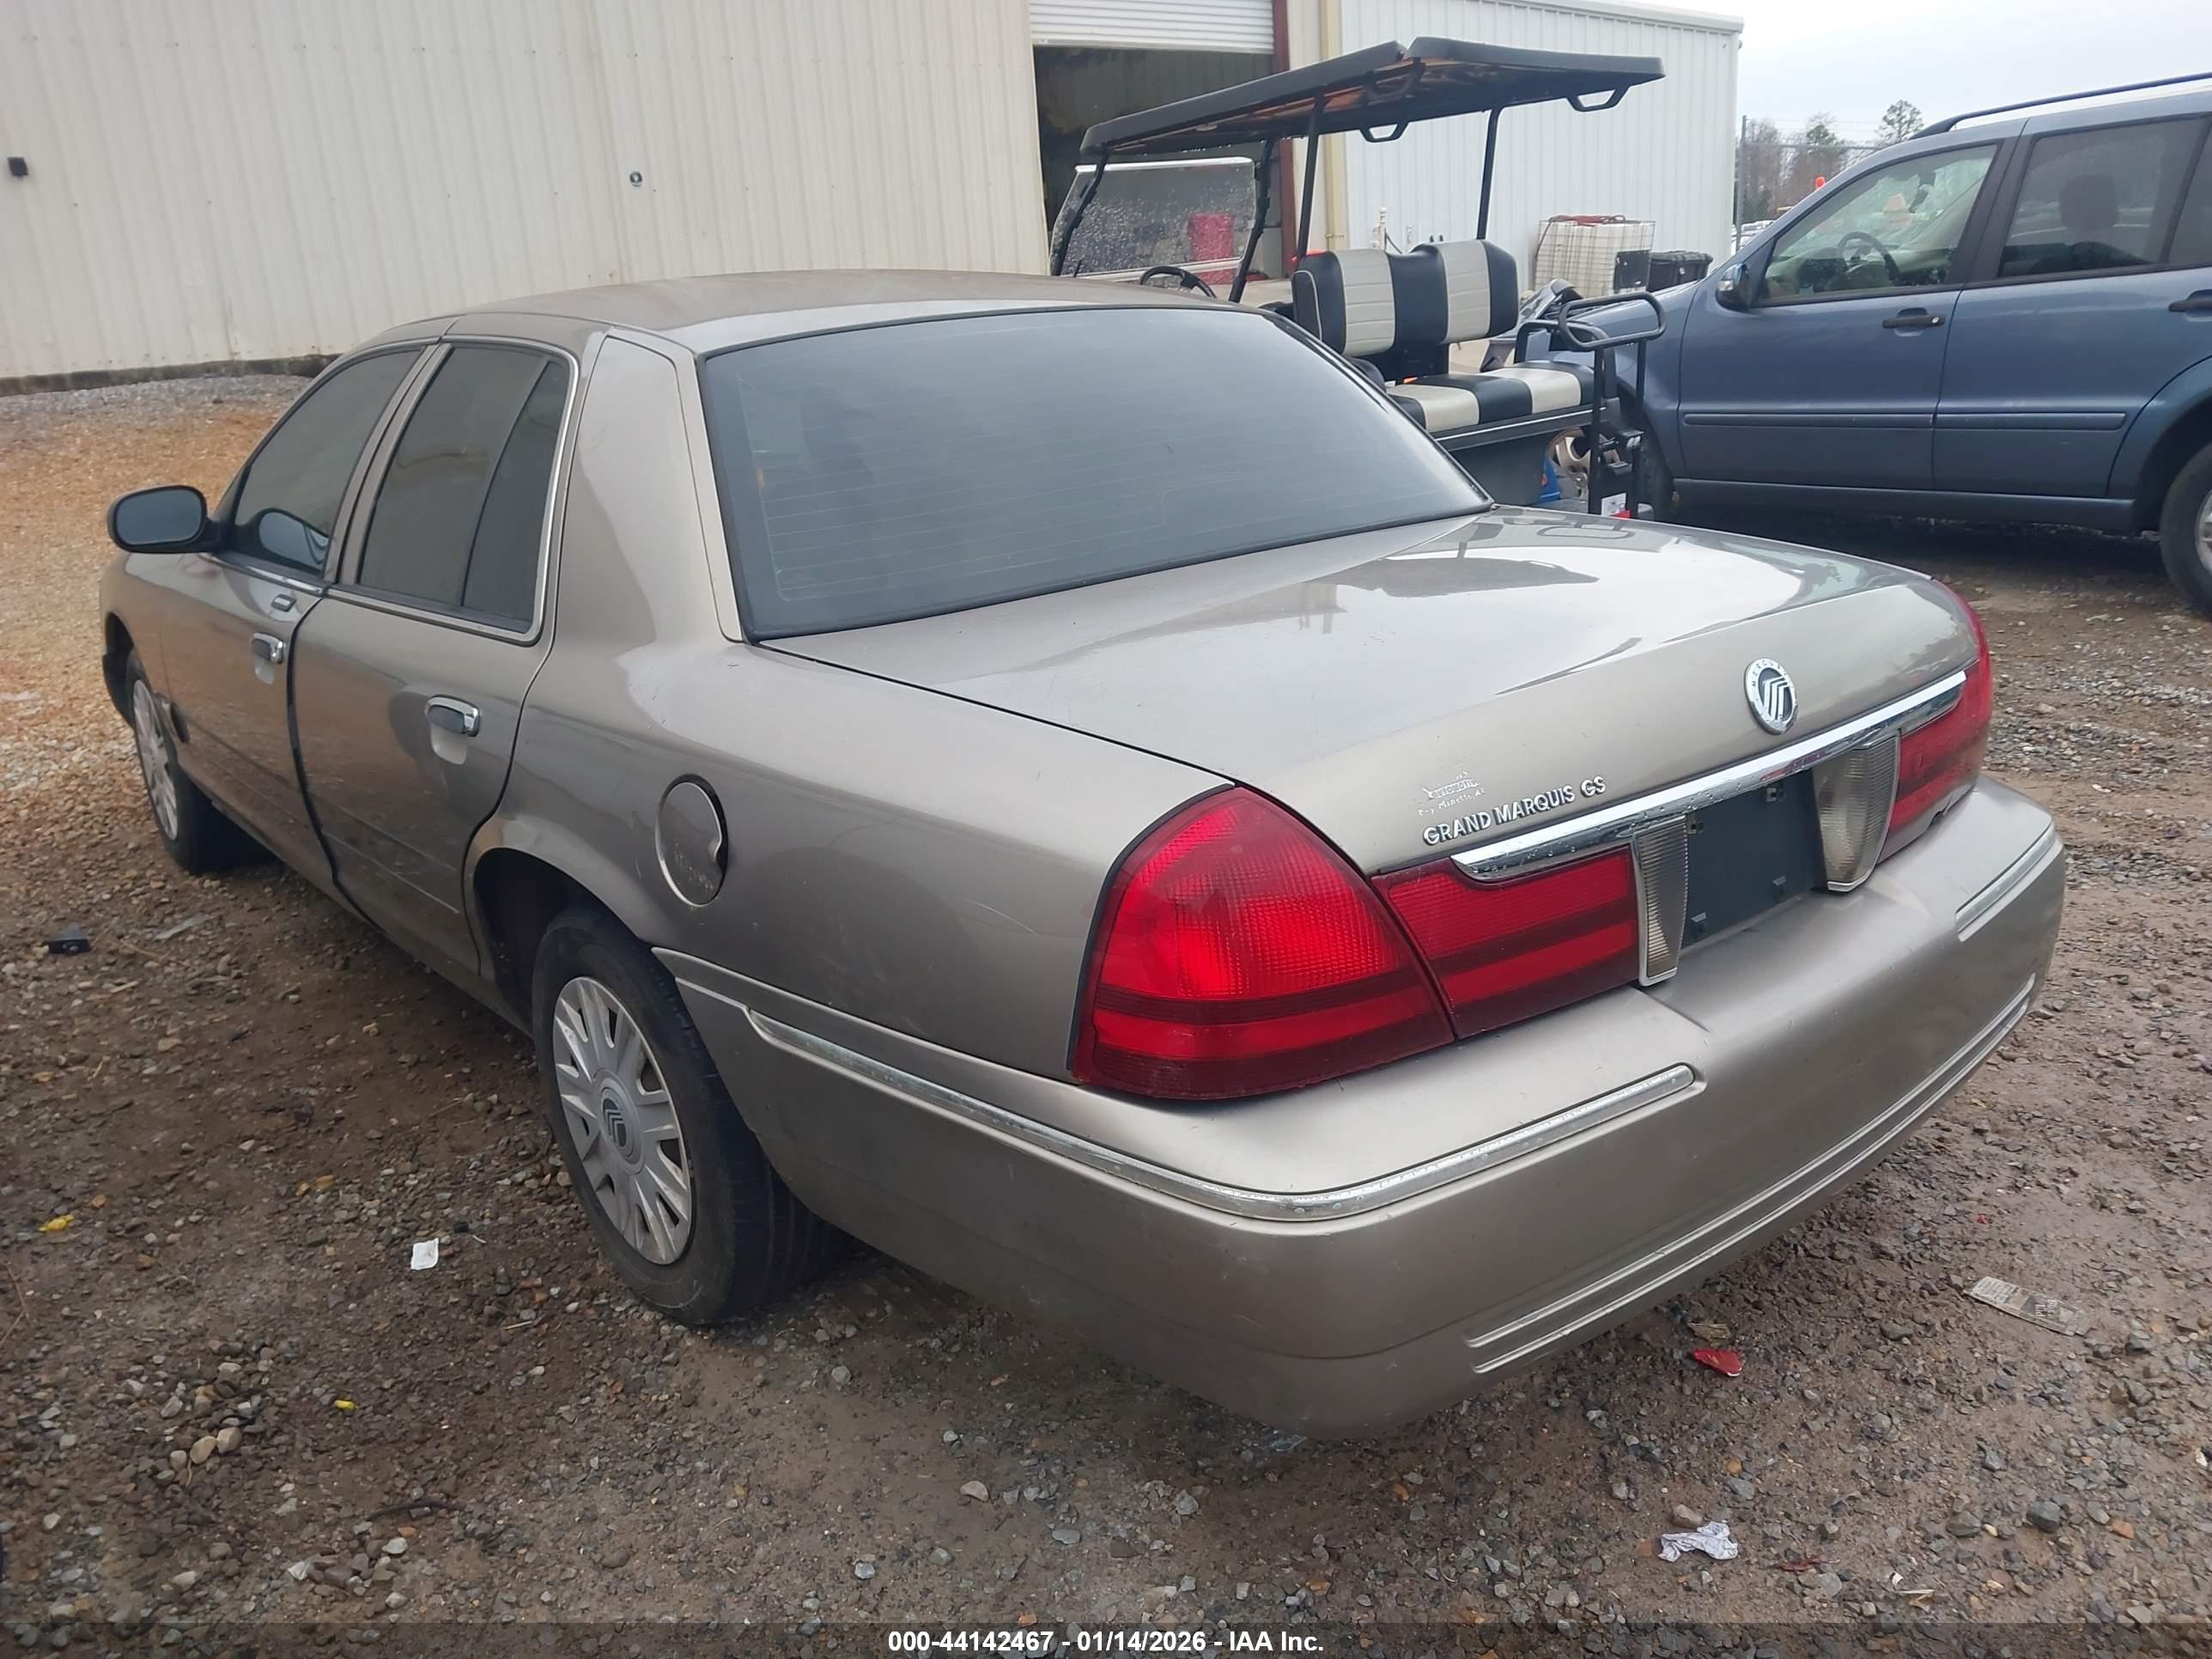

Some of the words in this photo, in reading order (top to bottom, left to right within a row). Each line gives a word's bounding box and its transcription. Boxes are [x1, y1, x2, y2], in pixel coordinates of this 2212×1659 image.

[1423, 811, 1492, 845] GRAND
[1492, 785, 1575, 825] MARQUIS
[1580, 775, 1607, 798] GS
